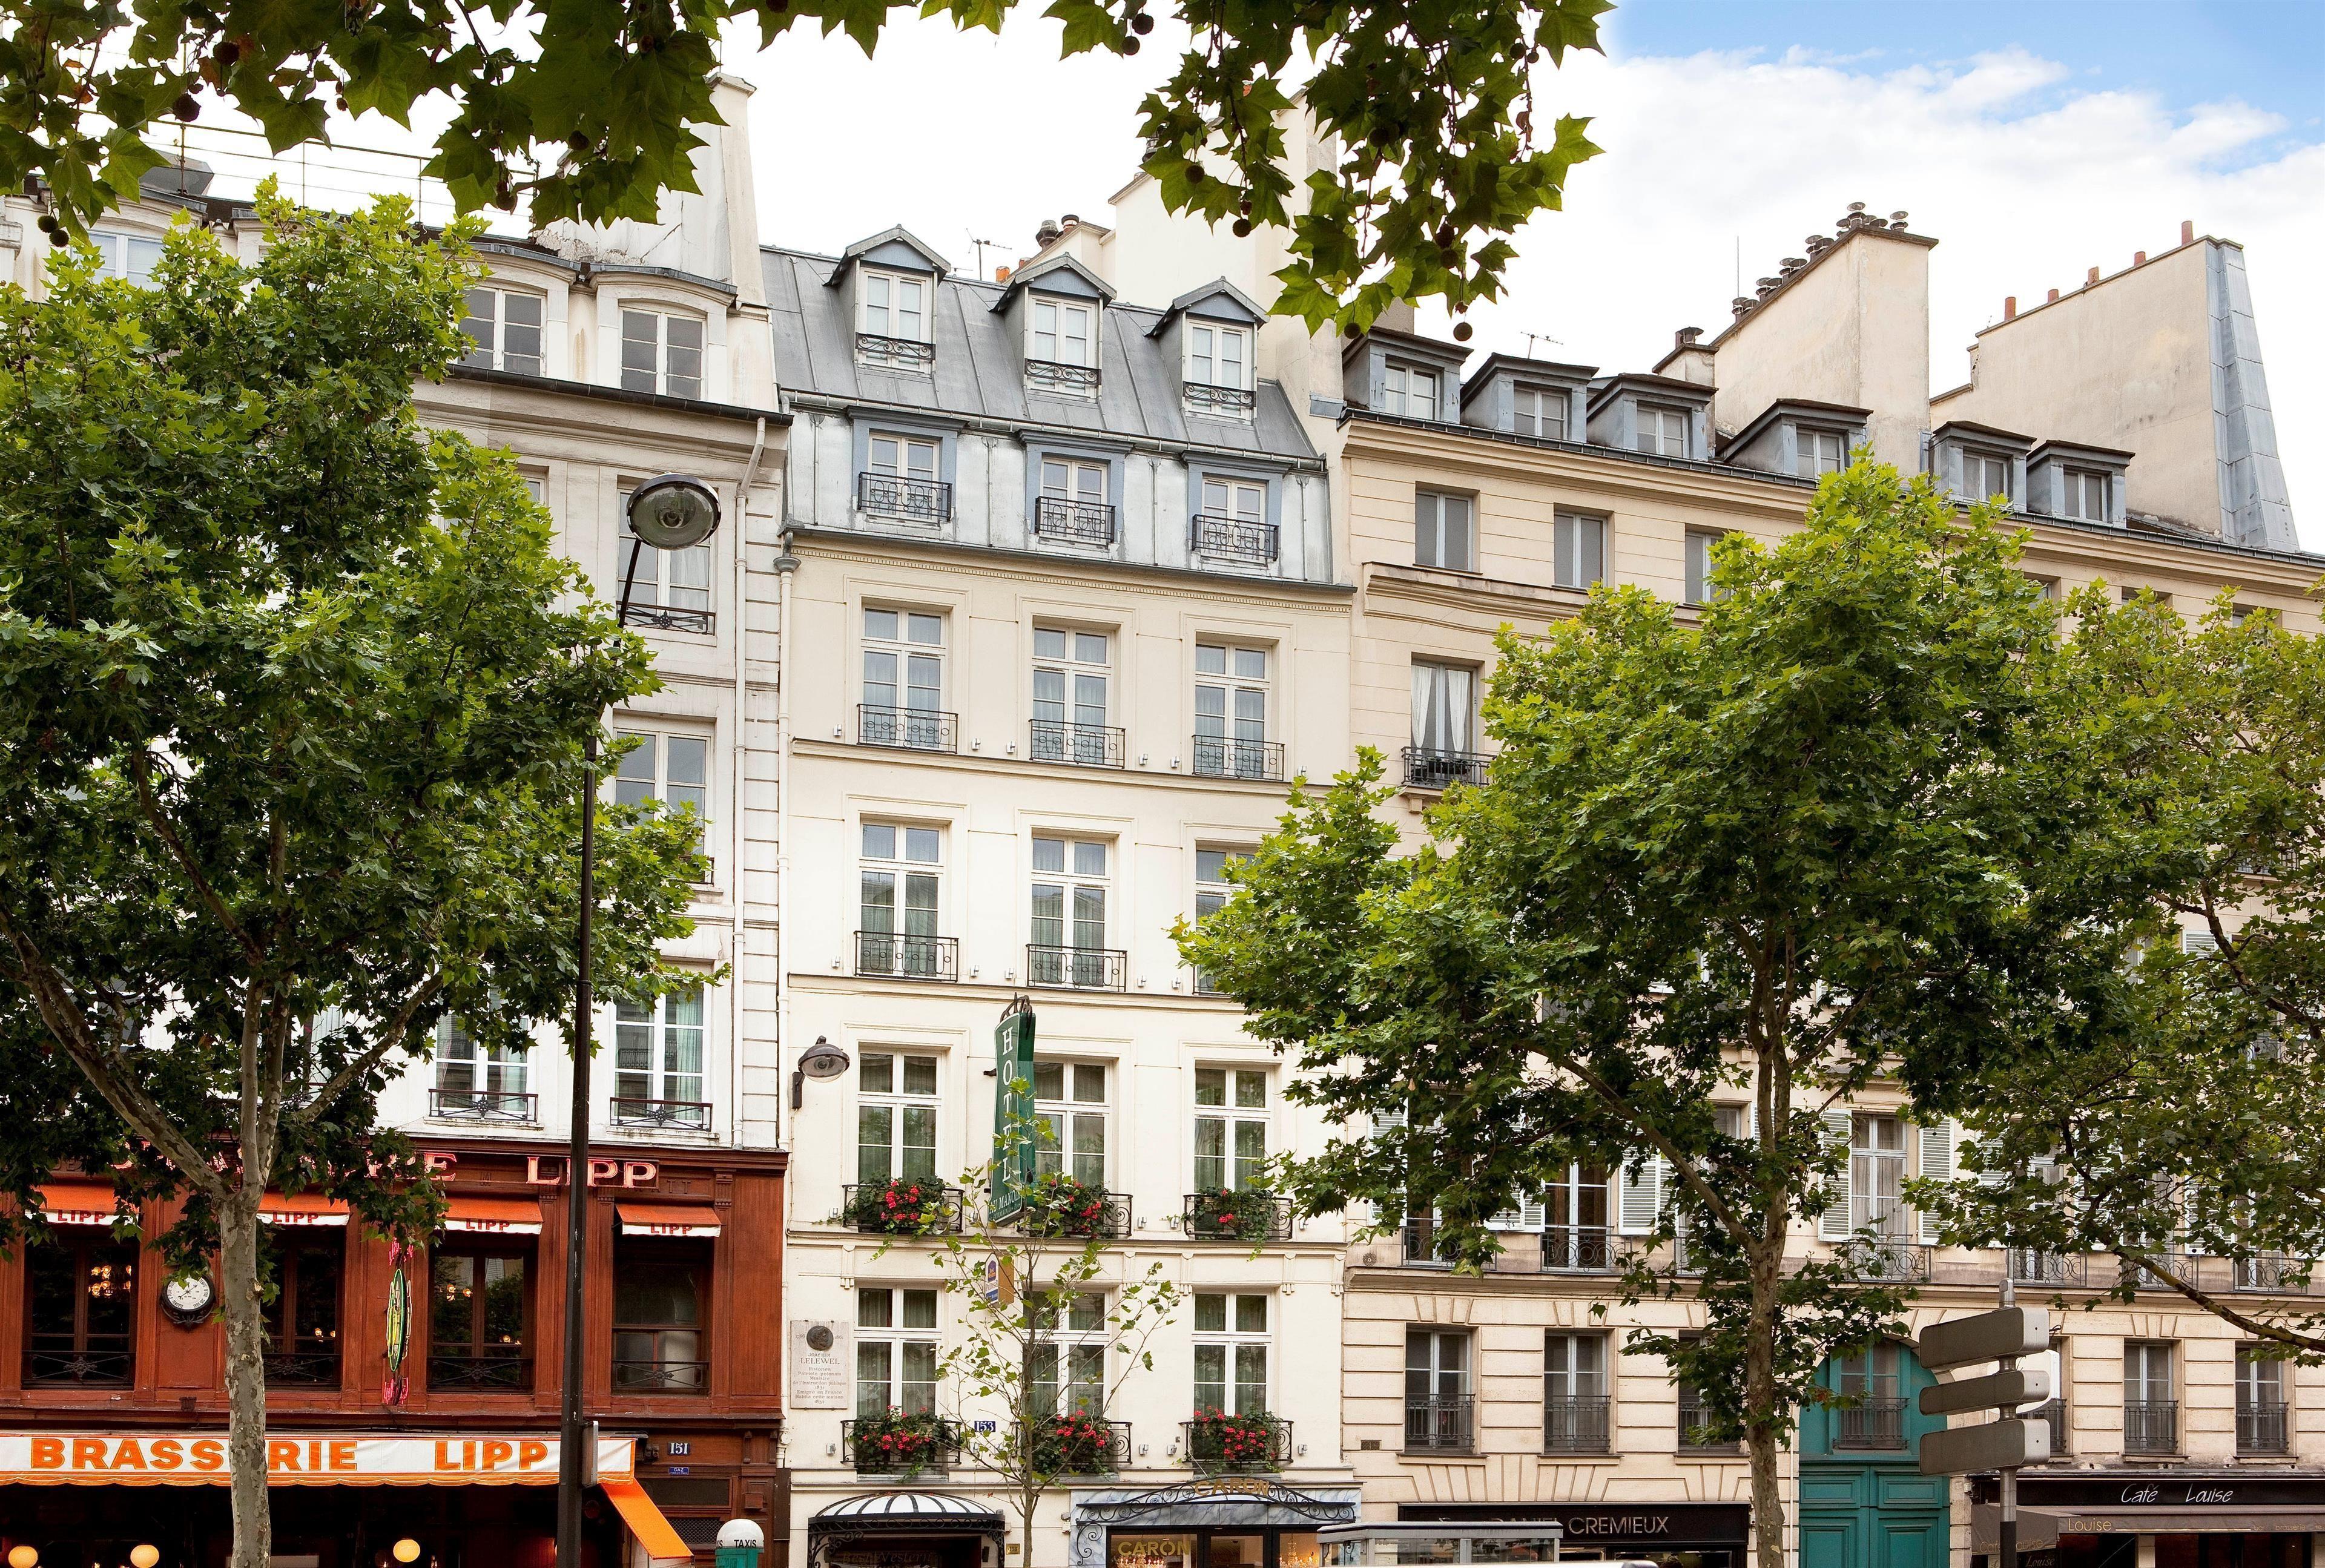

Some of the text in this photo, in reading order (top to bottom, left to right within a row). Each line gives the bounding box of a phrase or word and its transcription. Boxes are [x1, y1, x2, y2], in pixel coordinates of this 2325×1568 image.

[1002, 1027, 1014, 1182] HOTEL
[526, 1156, 656, 1188] LPP
[58, 1210, 106, 1223] LIPP
[273, 1211, 318, 1224] LIPP
[466, 1219, 510, 1231] LIPP
[650, 1223, 693, 1234] LIPP
[976, 1421, 994, 1432] 153
[31, 1438, 548, 1471] BRASSRIE LIPP
[670, 1443, 688, 1454] 151
[1195, 1477, 1269, 1496] CARON
[2121, 1483, 2234, 1503] Café Louise
[1569, 1517, 1669, 1534] CREMIEUX
[2068, 1518, 2112, 1531] Louise
[734, 1539, 757, 1549] TAXIS
[1118, 1541, 1190, 1556] CARON
[2016, 1538, 2043, 1551] ouise
[2025, 1555, 2055, 1567] Louise
